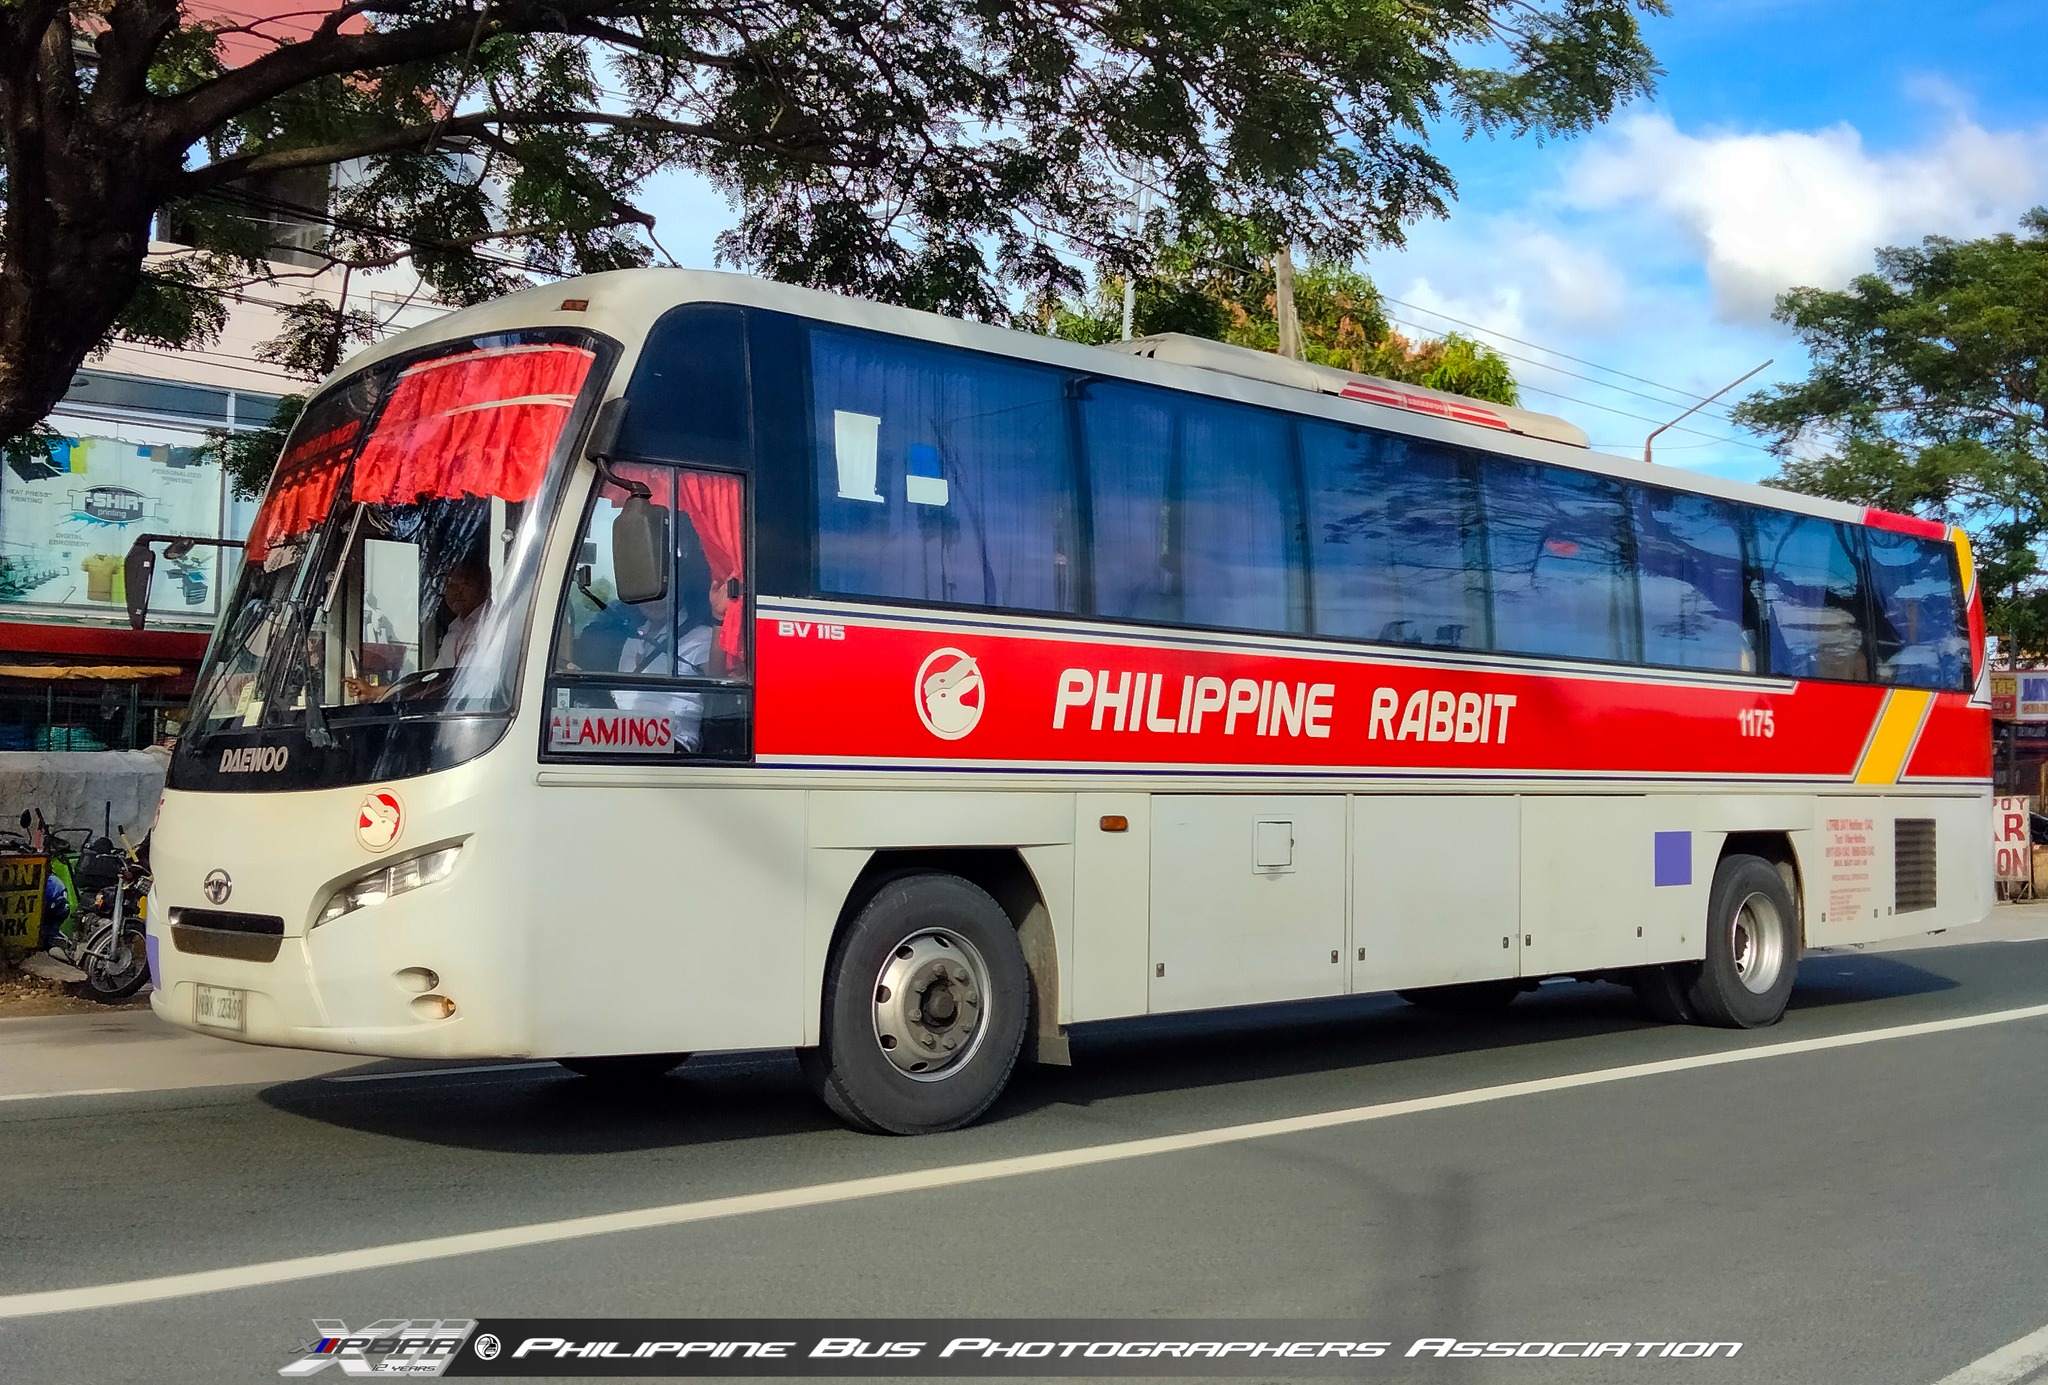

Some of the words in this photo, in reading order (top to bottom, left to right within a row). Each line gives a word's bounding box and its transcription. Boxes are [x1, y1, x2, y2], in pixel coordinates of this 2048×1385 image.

[6, 488, 24, 496] HEAT
[66, 489, 161, 518] T-SHIRT
[97, 508, 128, 519] printing
[56, 533, 84, 541] DIGITAL
[778, 621, 811, 638] BV
[816, 624, 846, 641] 115
[1052, 667, 1336, 739] PHILIPPINE
[1367, 686, 1518, 745] RABBIT
[1737, 708, 1776, 739] 1175
[218, 745, 290, 773] DAEWOO
[14, 894, 38, 914] AT
